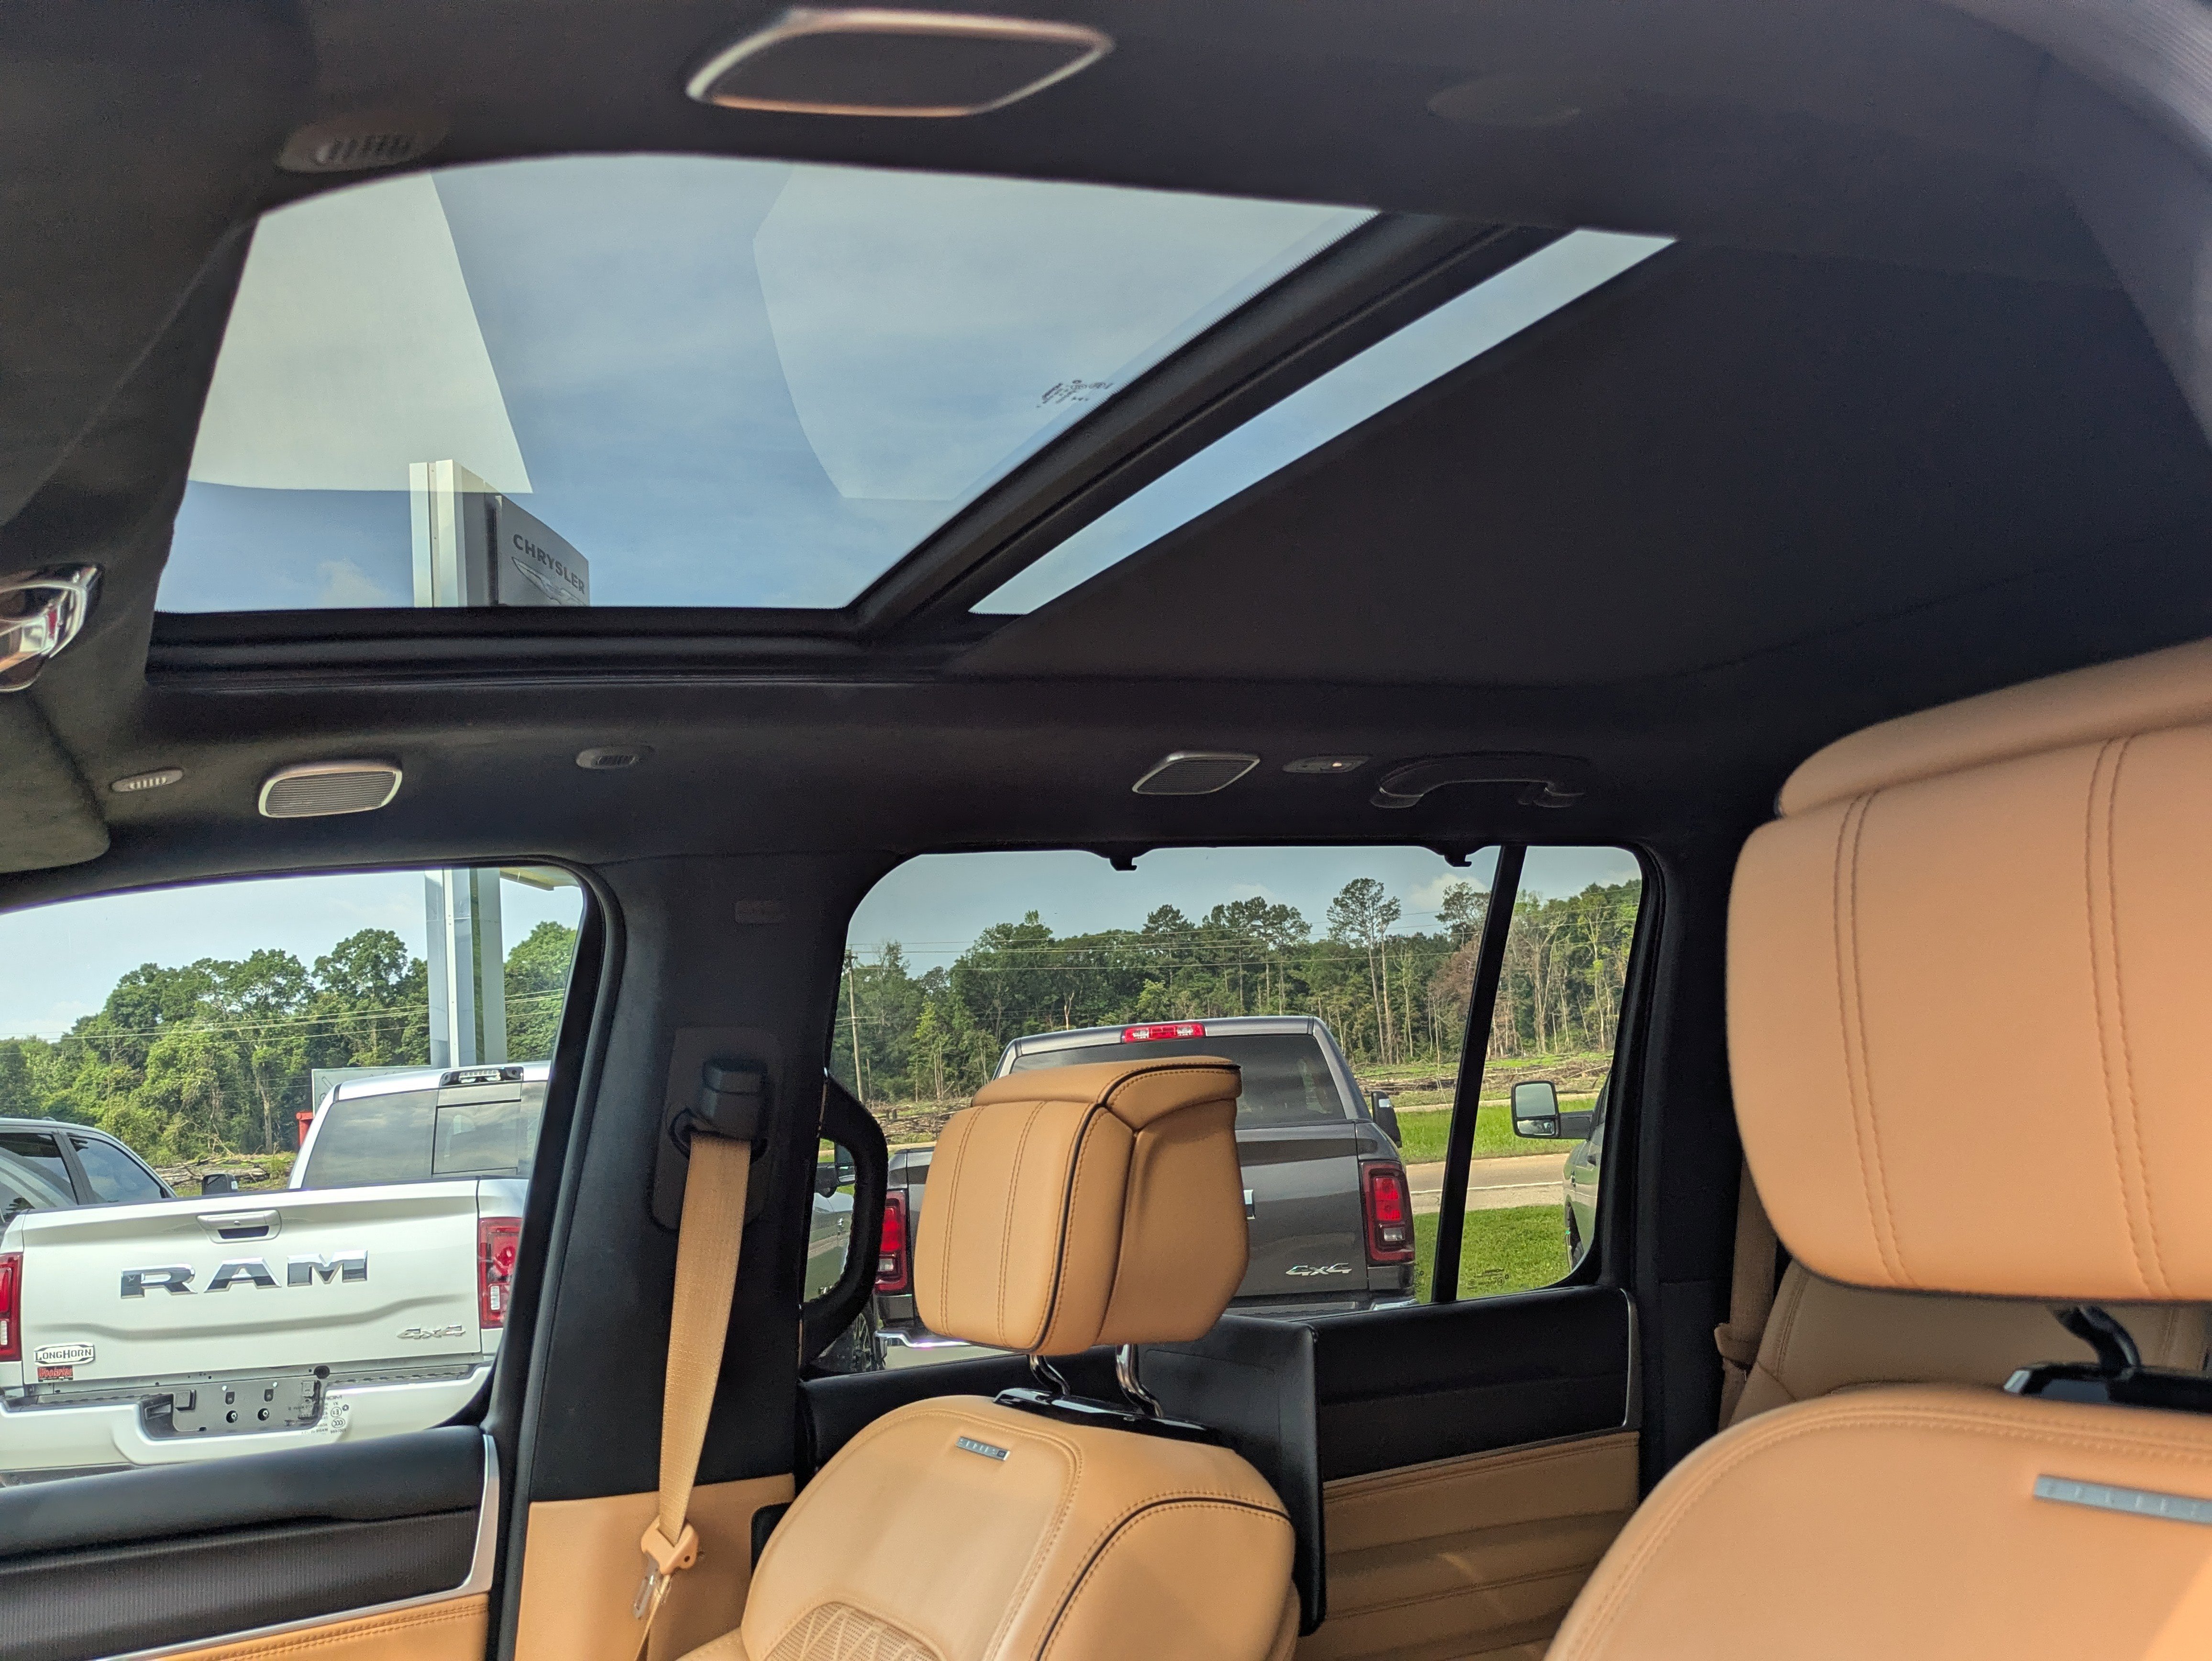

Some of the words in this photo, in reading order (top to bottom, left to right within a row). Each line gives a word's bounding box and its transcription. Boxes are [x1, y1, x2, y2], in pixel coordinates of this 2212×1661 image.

[513, 534, 585, 594] CHRYSLER
[121, 1250, 368, 1299] RAM
[1285, 1262, 1352, 1276] 4x4
[397, 1324, 466, 1339] 4x4
